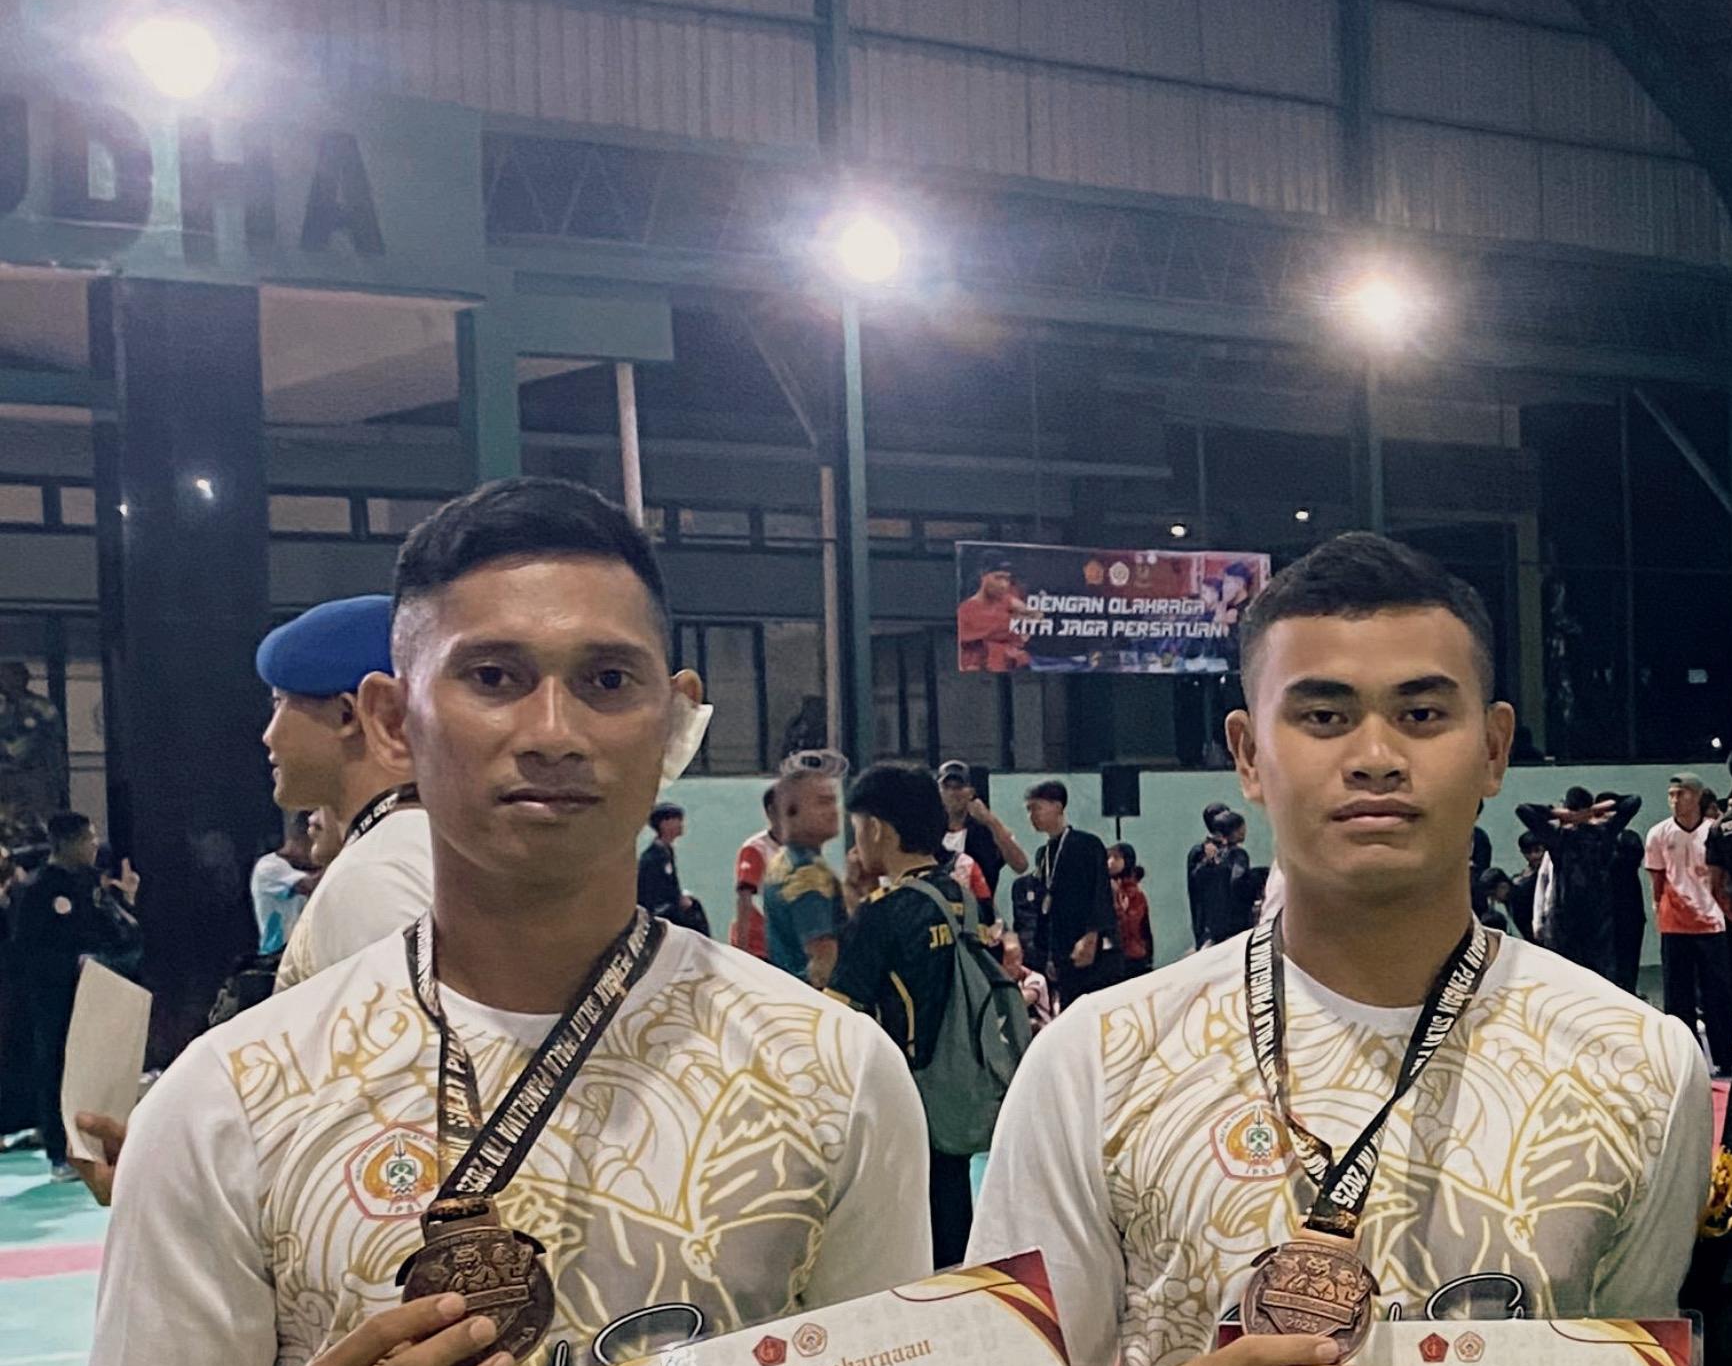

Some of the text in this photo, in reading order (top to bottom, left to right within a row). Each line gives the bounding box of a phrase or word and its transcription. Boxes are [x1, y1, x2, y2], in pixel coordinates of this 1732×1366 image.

[1027, 595, 1205, 615] DENGAN OLAHRAGA
[1009, 617, 1222, 638] KITA JAGA PERSATUAN
[1435, 962, 1476, 1017] PENCAK
[1328, 1164, 1370, 1209] 2025
